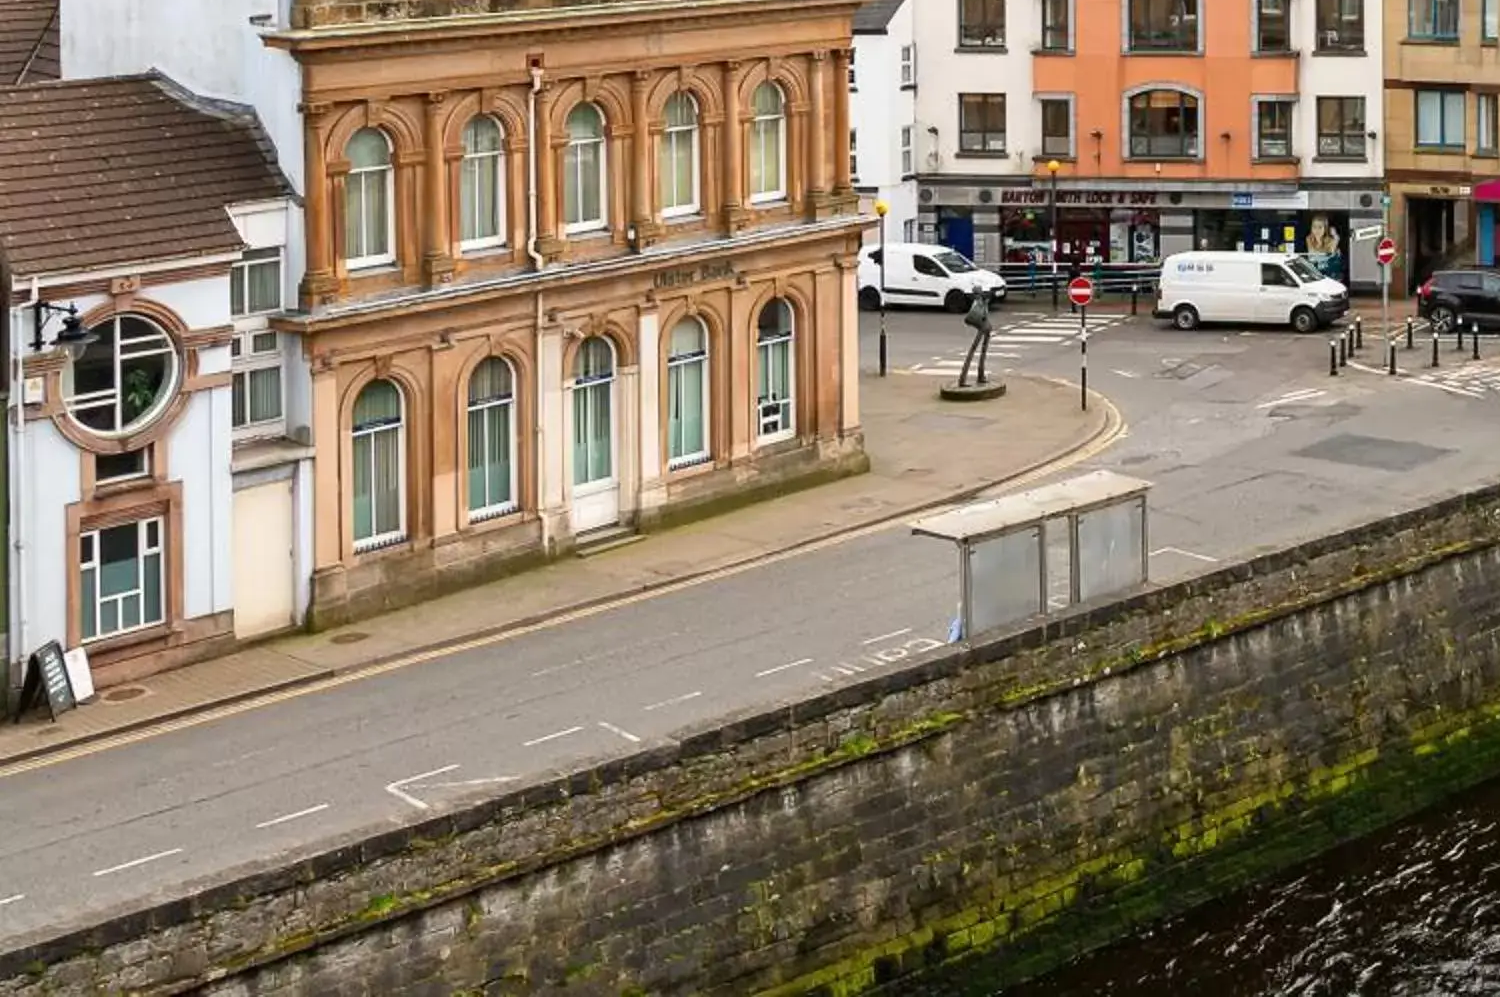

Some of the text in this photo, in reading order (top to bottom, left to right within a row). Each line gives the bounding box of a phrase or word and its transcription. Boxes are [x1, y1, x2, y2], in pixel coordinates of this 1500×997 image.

[1001, 189, 1046, 204] BARTON
[1086, 190, 1113, 204] LOCK
[654, 261, 735, 288] Ulster Bank
